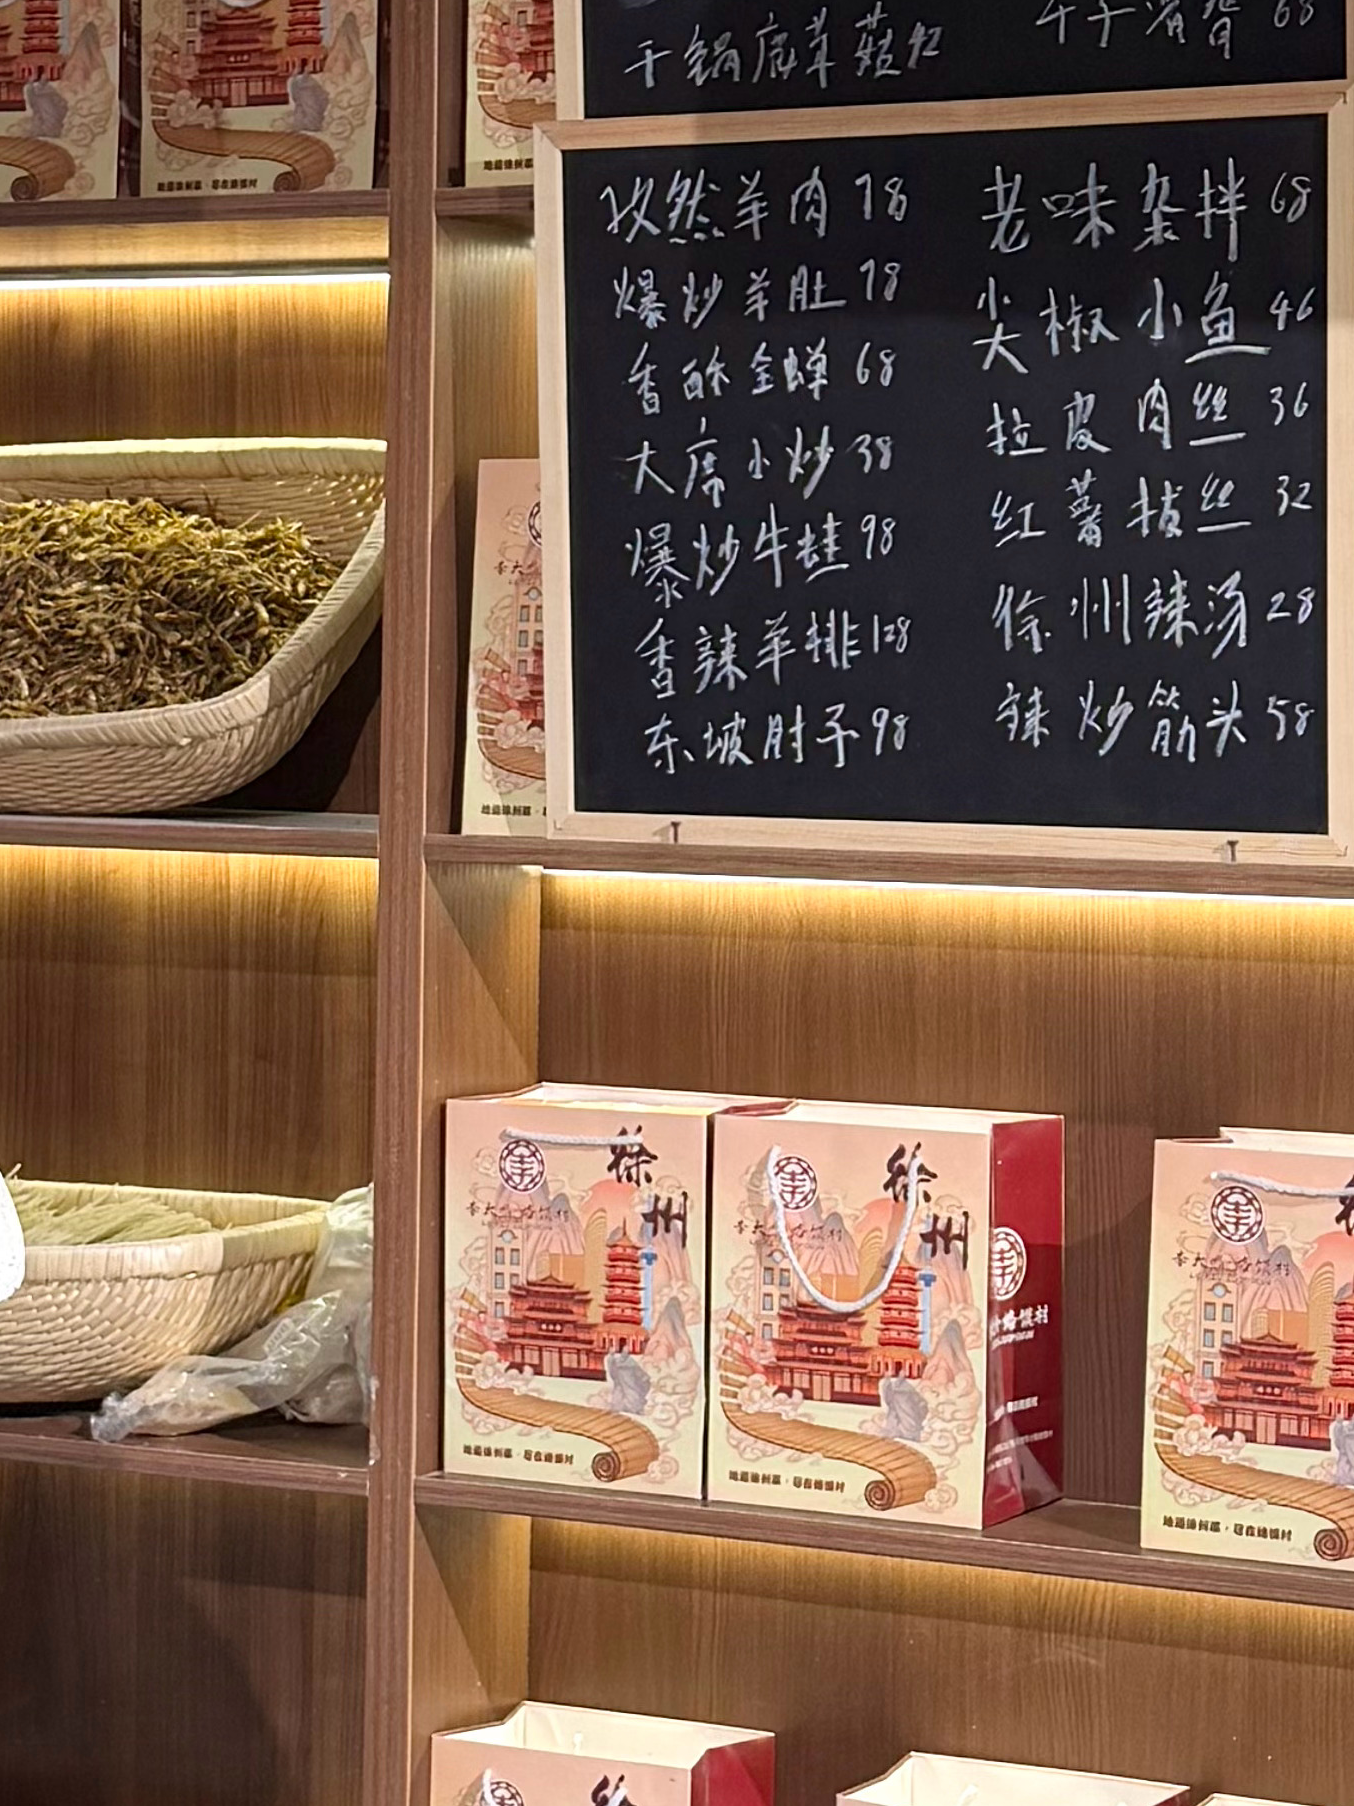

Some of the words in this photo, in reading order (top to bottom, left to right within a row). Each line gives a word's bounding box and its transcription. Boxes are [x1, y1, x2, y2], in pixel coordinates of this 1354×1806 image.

[1269, 171, 1313, 216] 68
[1269, 287, 1314, 334] 46
[855, 342, 895, 389] 68
[1270, 378, 1311, 424] 36
[847, 433, 893, 473] 38
[1275, 473, 1314, 516] 32
[861, 512, 899, 563] 98
[1265, 587, 1316, 627] 28
[870, 704, 910, 757] 98
[1265, 696, 1314, 744] 58
